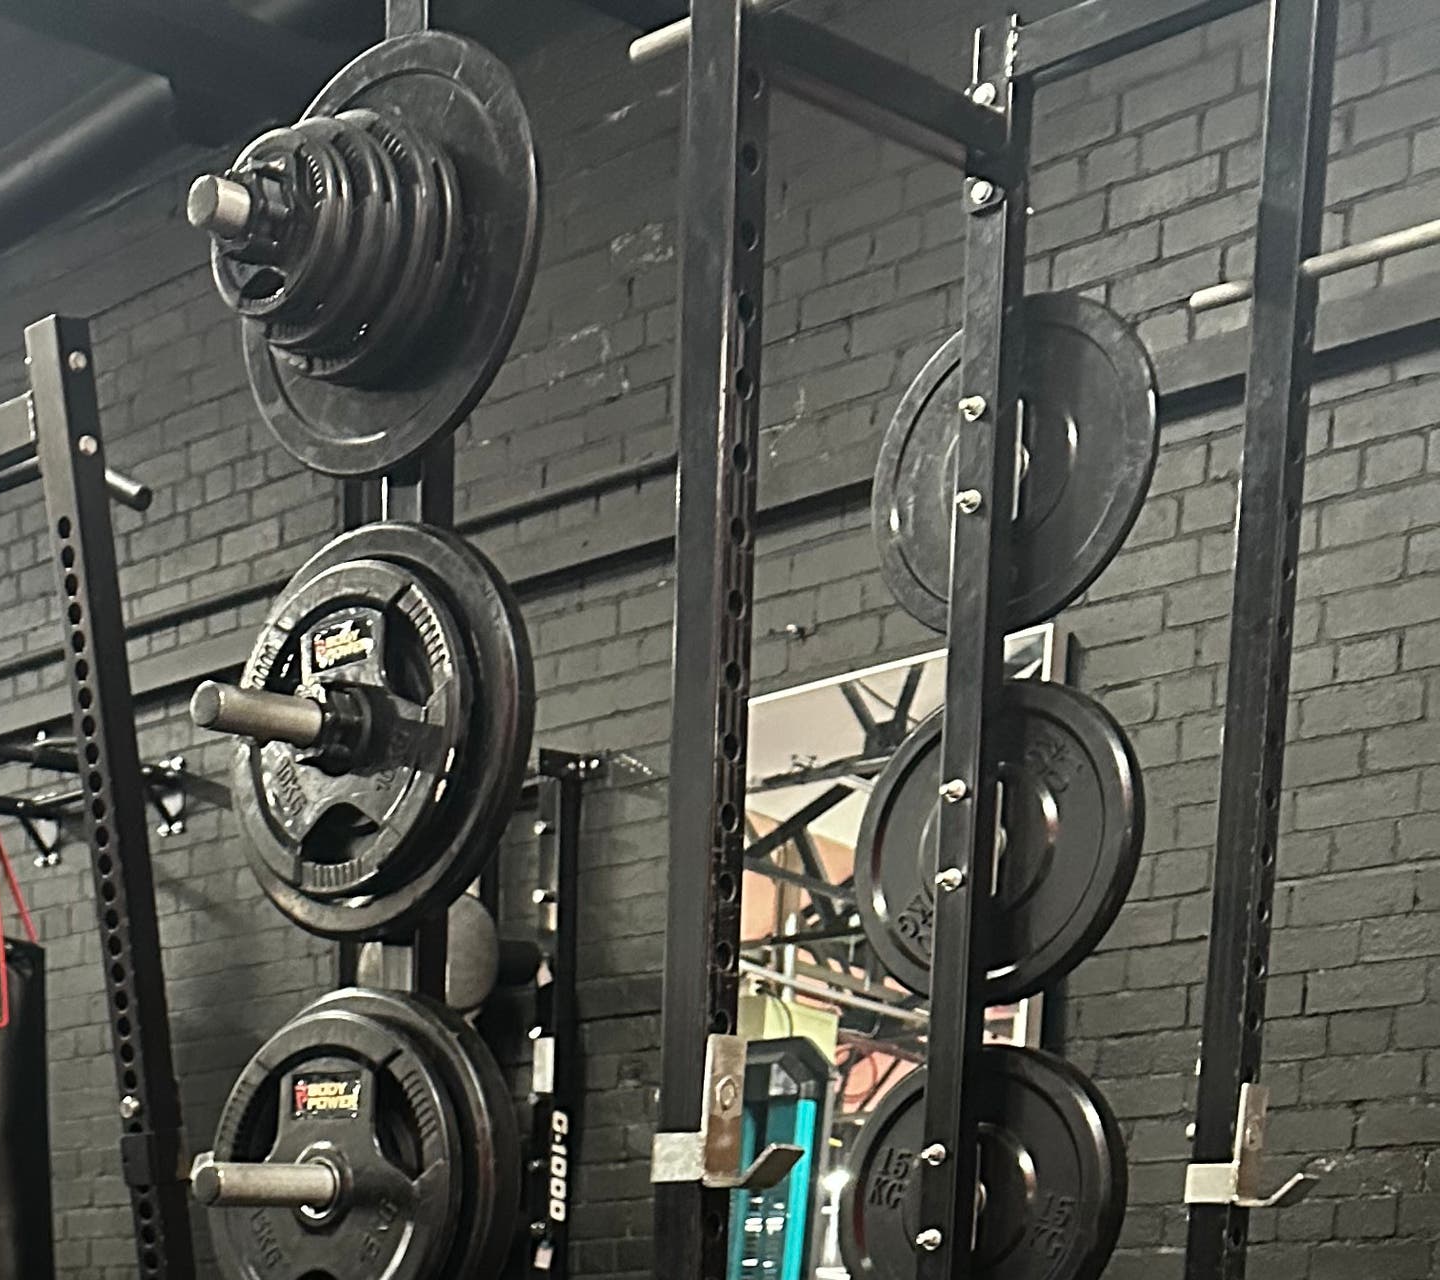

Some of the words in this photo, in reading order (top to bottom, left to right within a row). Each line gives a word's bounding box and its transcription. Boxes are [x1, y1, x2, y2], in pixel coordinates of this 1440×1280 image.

[307, 1082, 348, 1096] BODY
[880, 1148, 913, 1181] 15
[869, 1176, 904, 1210] KG
